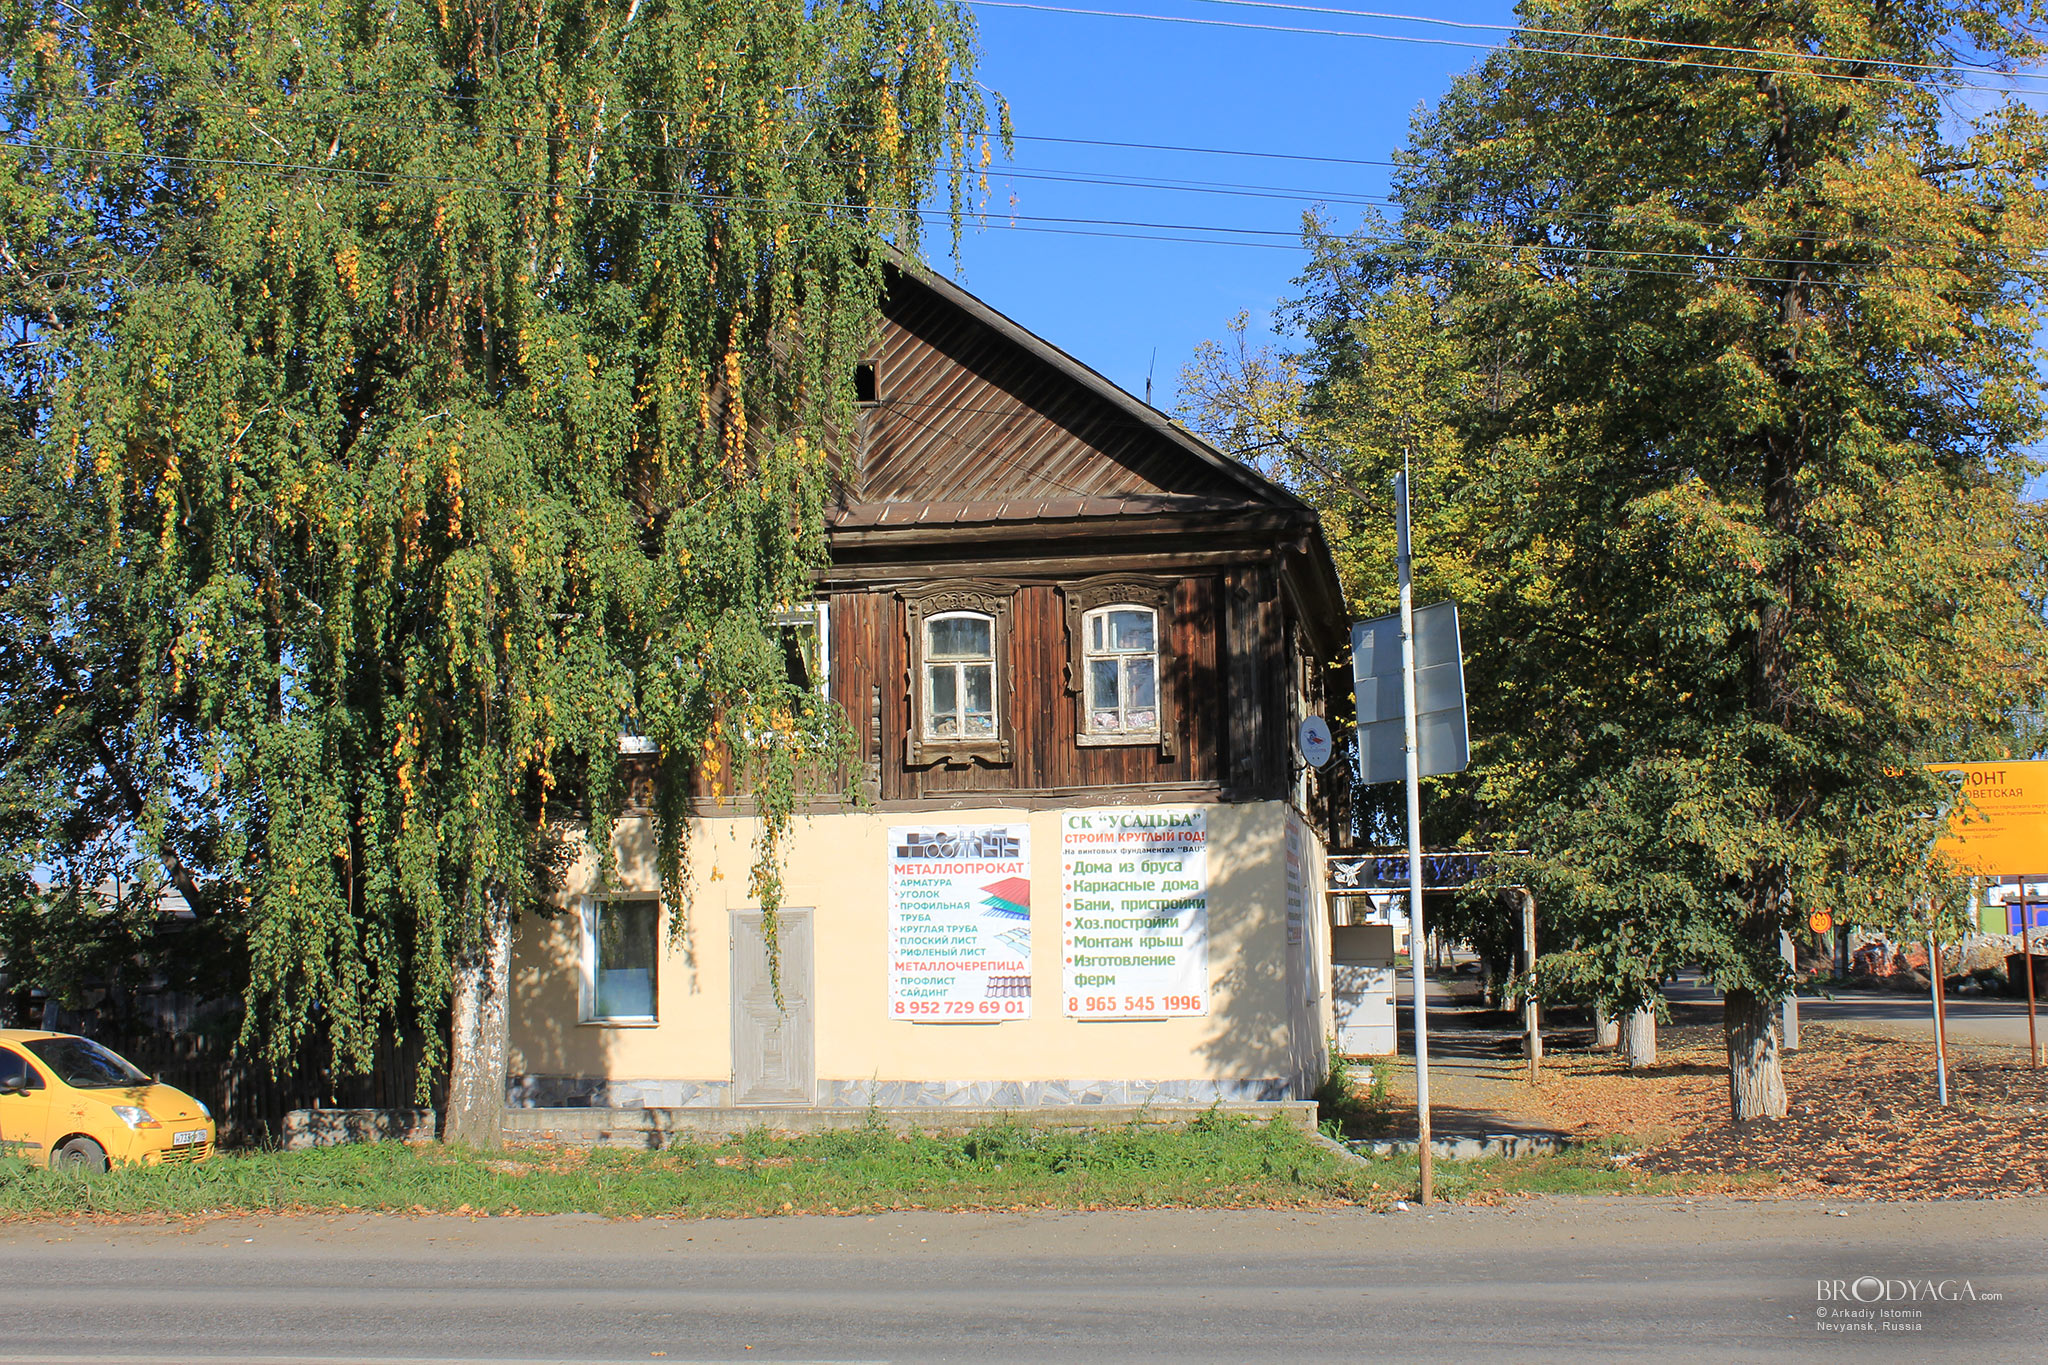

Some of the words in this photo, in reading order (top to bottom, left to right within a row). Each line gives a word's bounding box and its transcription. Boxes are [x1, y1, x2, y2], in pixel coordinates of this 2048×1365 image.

[1068, 816, 1092, 829] СК
[1065, 834, 1114, 843] СТРОИМ
[1118, 829, 1174, 842] КРУГЛЫЙ
[1178, 832, 1205, 842] ГОД!
[1121, 847, 1174, 855] фундаментах
[894, 863, 1024, 874] МЕТАЛЛОПРОКАТ
[1073, 861, 1112, 875] Дома
[1119, 863, 1135, 873] из
[1141, 860, 1182, 874] бруса
[1073, 880, 1155, 894] Каркасные
[1162, 880, 1199, 892] дома
[900, 890, 940, 898] УГОЛОК
[900, 902, 970, 910] ПРОФИЛЬНАЯ
[1074, 899, 1114, 912] Бани,
[1121, 897, 1205, 912] пристройки
[1074, 916, 1179, 931] Хоз.постройки
[900, 936, 948, 944] ПЛОСКИЙ
[1074, 936, 1133, 948] Монтаж
[1140, 936, 1183, 949] крыш
[901, 947, 957, 956] РИФЛЕНЫЙ
[960, 948, 986, 956] ЛИСТ
[895, 961, 1024, 972] МЕТАЛЛОЧЕРЕПИЦА
[1074, 955, 1176, 966] Изготовление
[900, 977, 956, 985] ПРОФЛИСТ
[1074, 973, 1116, 987] ферм
[900, 987, 948, 997] САЙДИНГ
[895, 1001, 905, 1014] 8
[910, 1001, 940, 1014] 952
[944, 1001, 974, 1013] 729
[979, 1001, 1000, 1013] 69
[1004, 1001, 1024, 1013] 01
[1069, 997, 1078, 1012] 8
[1086, 997, 1116, 1011] 965
[1124, 996, 1155, 1011] 545
[1162, 996, 1201, 1010] 1996
